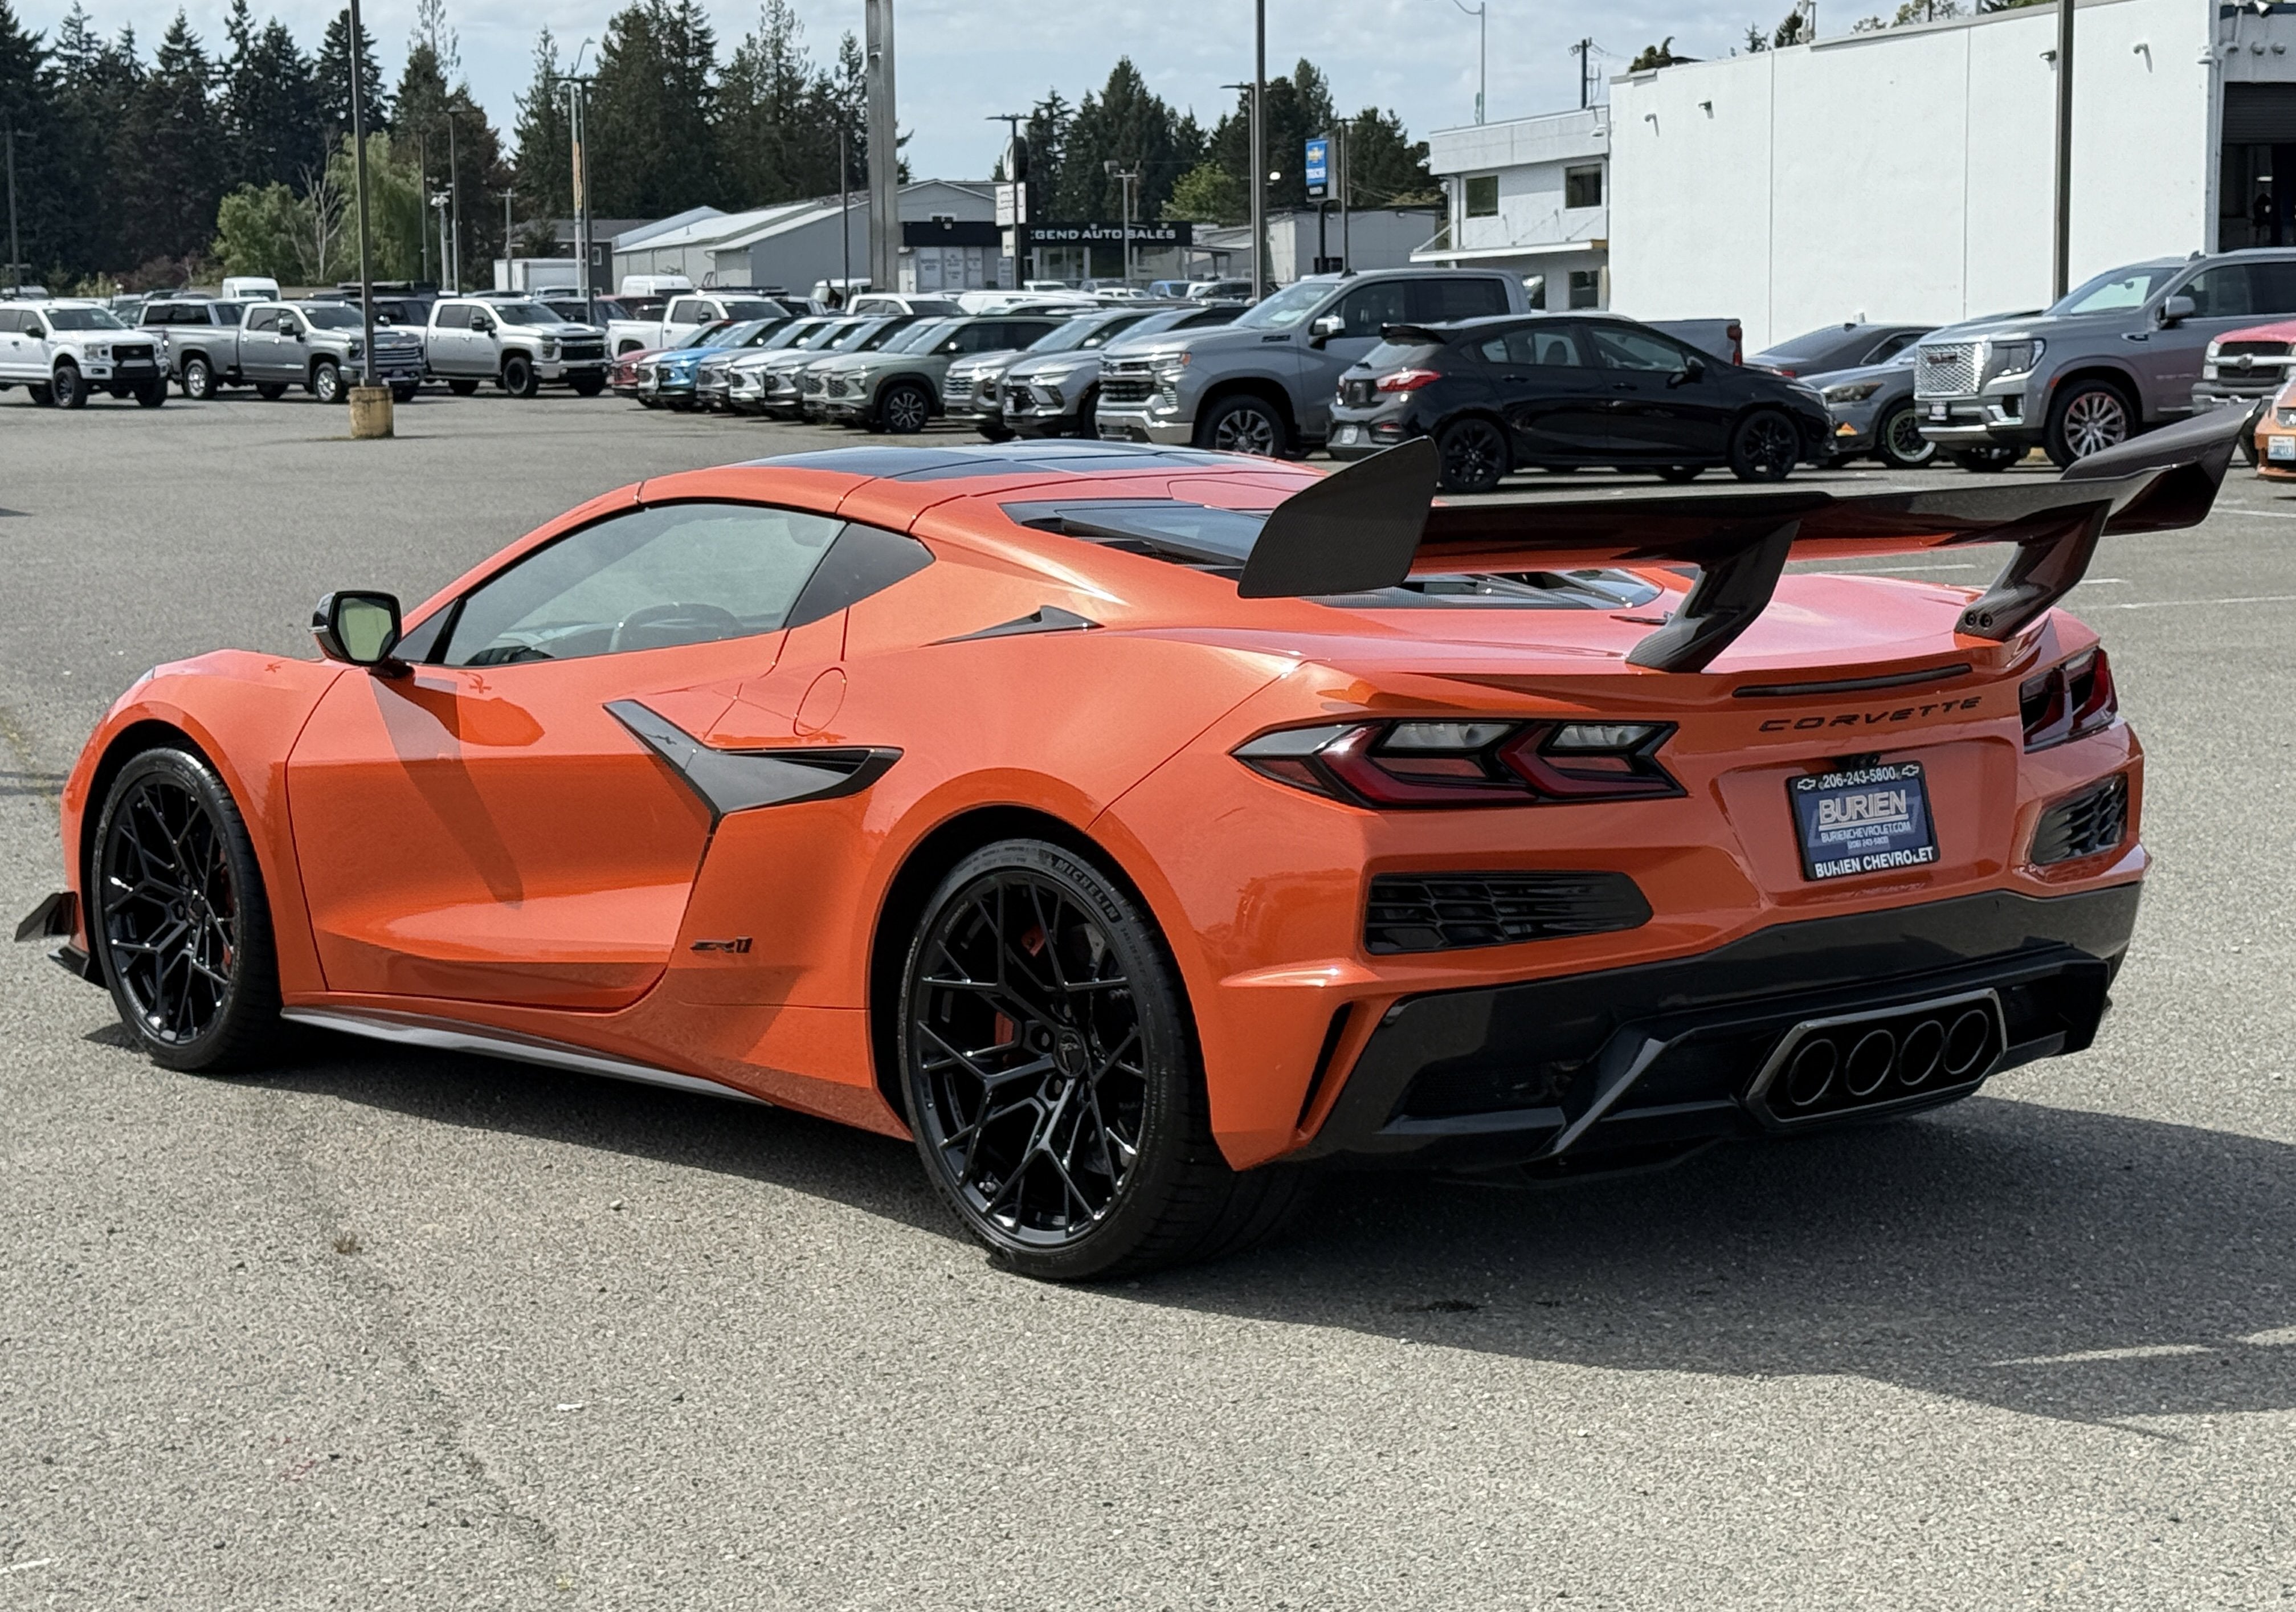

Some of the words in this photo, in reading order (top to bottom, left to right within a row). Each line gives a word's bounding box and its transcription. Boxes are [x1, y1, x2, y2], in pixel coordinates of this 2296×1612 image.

[1030, 230, 1079, 240] GEND
[1082, 230, 1122, 239] AUTO
[1127, 230, 1176, 239] SALES
[1759, 696, 1982, 732] CORVETTE
[1823, 766, 1895, 789] 206-243-5800
[1819, 789, 1906, 825] BURIEN
[1863, 846, 1934, 871] CHEVROLET
[1055, 859, 1118, 922] MICHELIN
